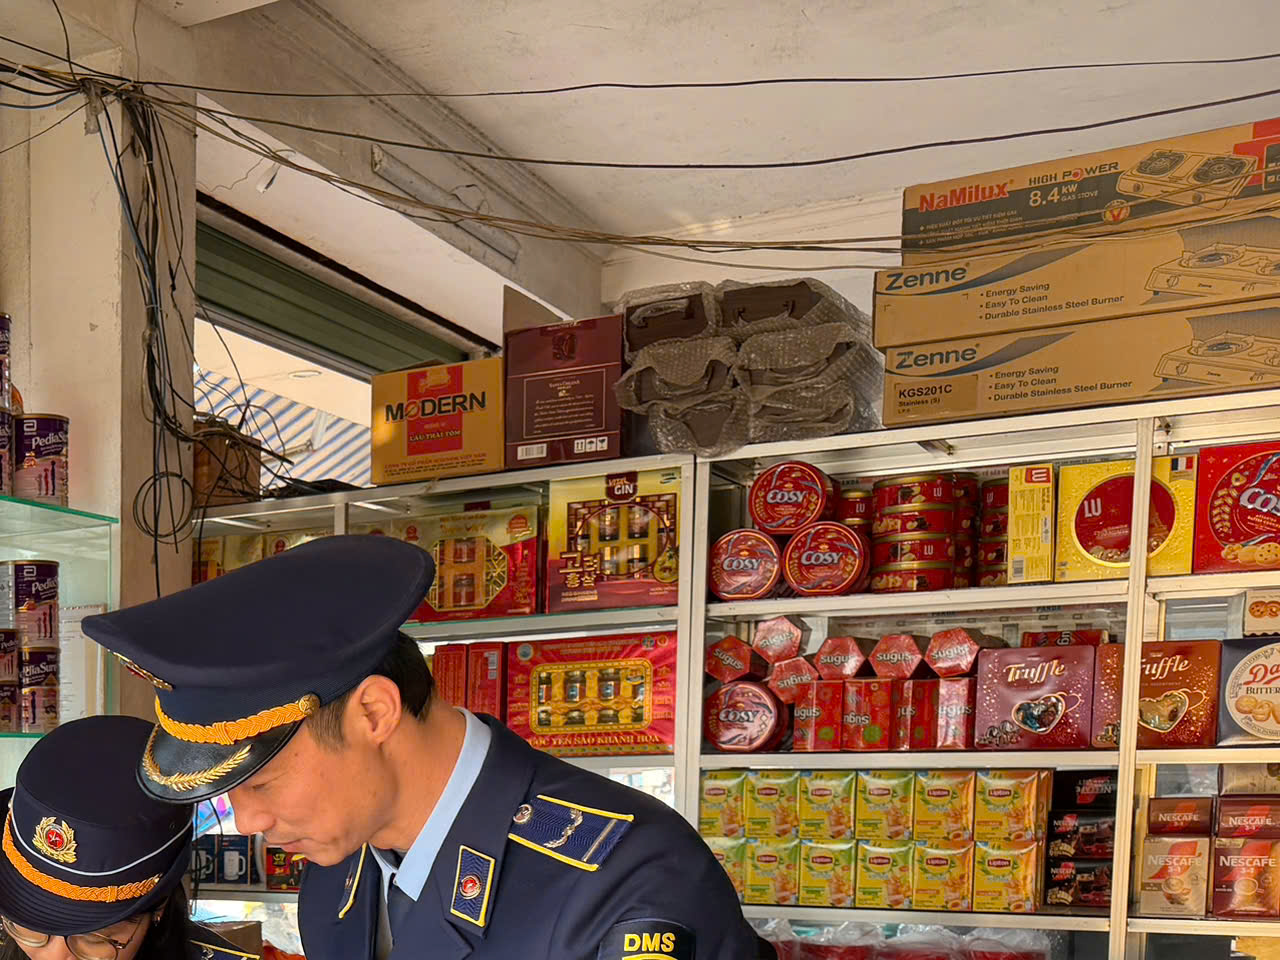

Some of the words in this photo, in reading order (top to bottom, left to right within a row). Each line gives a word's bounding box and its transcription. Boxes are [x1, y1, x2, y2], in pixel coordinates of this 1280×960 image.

[1029, 173, 1057, 186] HIGH
[1063, 161, 1119, 181] POWER
[1029, 187, 1060, 207] 8.4
[1061, 183, 1078, 195] kW
[919, 183, 1009, 212] NaMilux
[885, 266, 968, 291] Zenne
[986, 287, 1018, 299] Energy
[1019, 282, 1050, 295] Saving
[984, 308, 1020, 320] Durable
[1022, 304, 1063, 315] Stainless
[1065, 300, 1089, 310] Steel
[1090, 295, 1124, 306] Burner
[985, 299, 1006, 310] Easy
[1008, 298, 1020, 307] To
[1021, 294, 1048, 304] Clean
[895, 348, 978, 370] Zenne
[995, 369, 1027, 380] Energy
[1028, 365, 1059, 377] Saving
[898, 384, 952, 399] KGS201C
[993, 391, 1029, 402] Durable
[1030, 387, 1072, 397] Stainless
[1074, 383, 1098, 393] Steel
[1099, 380, 1132, 390] Burner
[994, 382, 1016, 393] Easy
[1018, 381, 1029, 389] To
[1030, 377, 1057, 387] Clean
[614, 484, 634, 495] GIN
[766, 489, 806, 504] COSY
[933, 487, 942, 497] LU
[856, 503, 865, 512] LU
[1083, 498, 1102, 518] LU
[924, 545, 933, 555] LU
[722, 557, 761, 571] COSY
[801, 551, 842, 566] COSY
[713, 648, 744, 671] sugus
[876, 651, 912, 664] sugus
[1004, 659, 1065, 683] Truffle
[1141, 656, 1191, 680] ruffle
[719, 708, 758, 723] COSY
[623, 932, 676, 952] DMS
